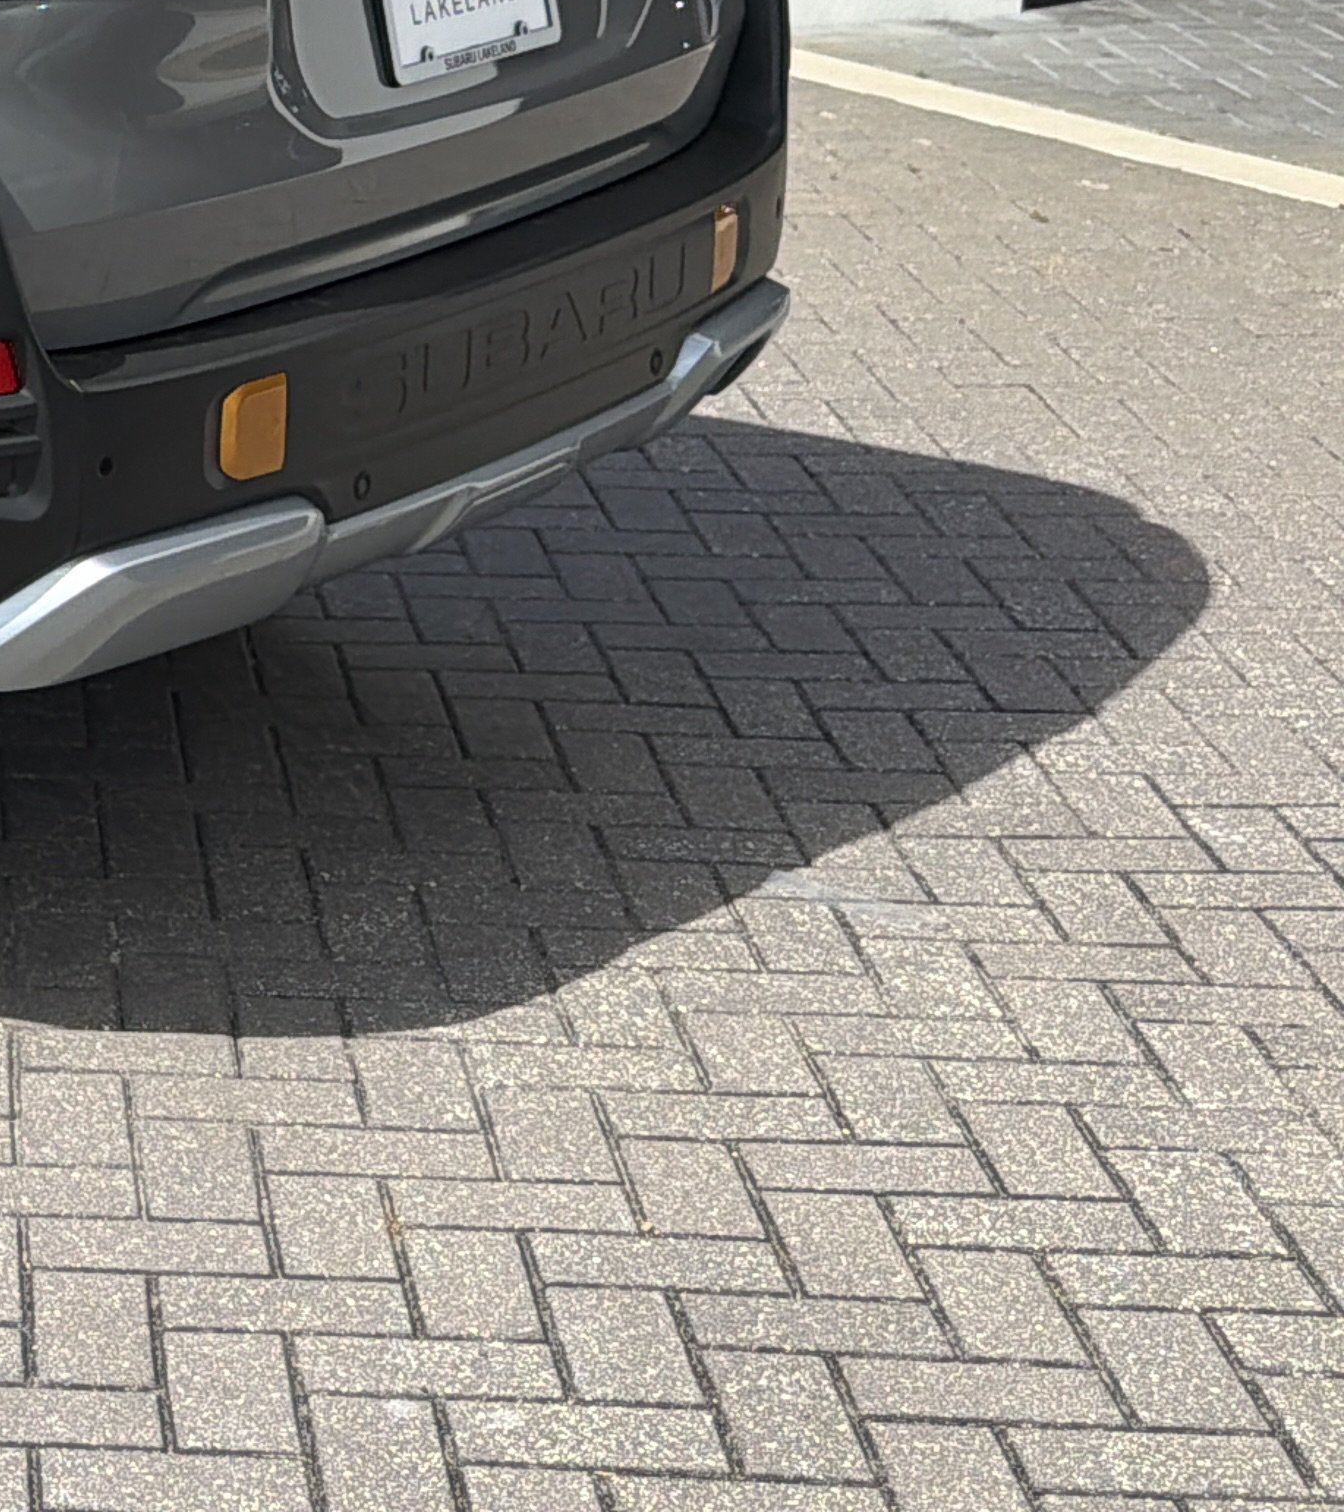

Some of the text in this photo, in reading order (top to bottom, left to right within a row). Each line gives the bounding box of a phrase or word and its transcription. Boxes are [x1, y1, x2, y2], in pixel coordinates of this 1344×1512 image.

[444, 39, 517, 70] SUBARU LAKELAND
[342, 242, 686, 416] SUBARU
